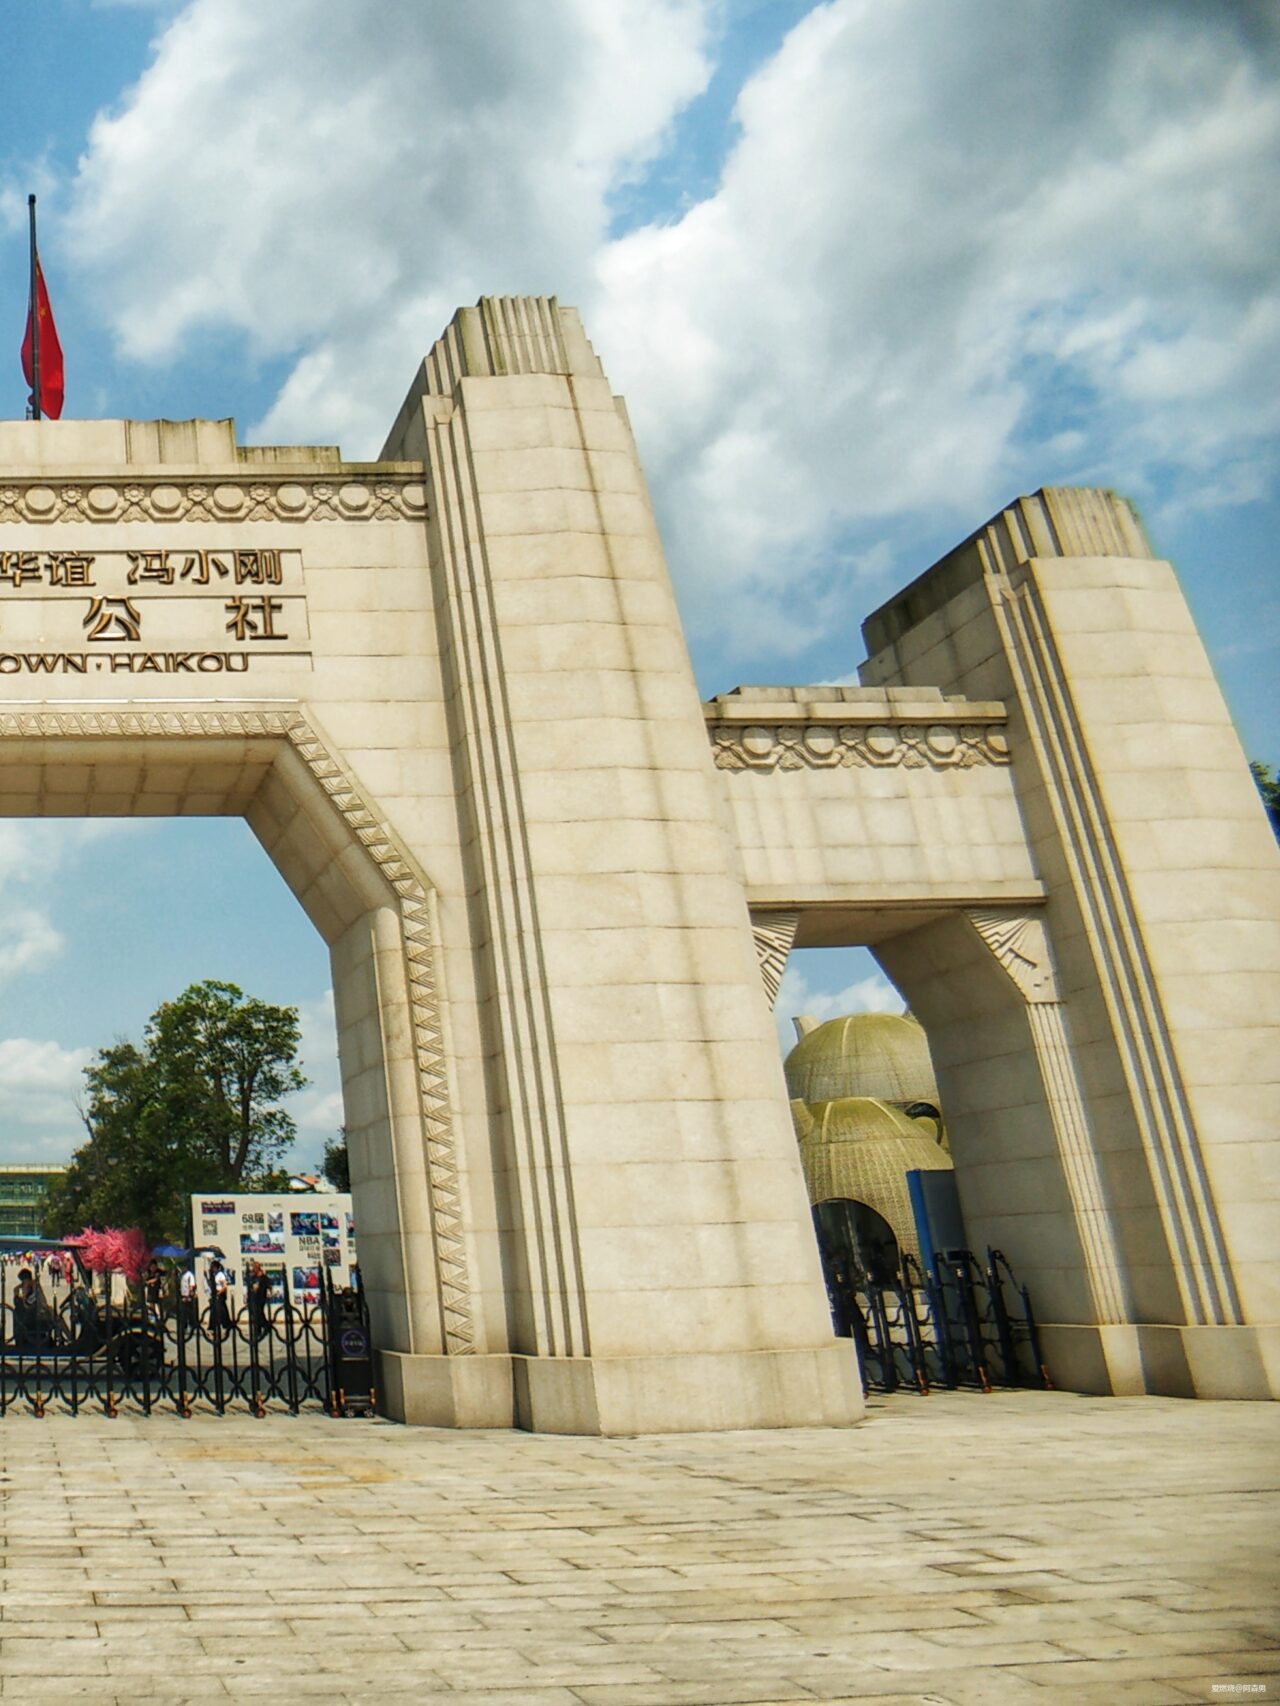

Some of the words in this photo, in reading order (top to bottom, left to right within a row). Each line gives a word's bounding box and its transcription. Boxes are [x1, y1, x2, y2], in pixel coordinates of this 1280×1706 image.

[126, 548, 283, 586] 冯小刚
[299, 1236, 320, 1246] NBA
